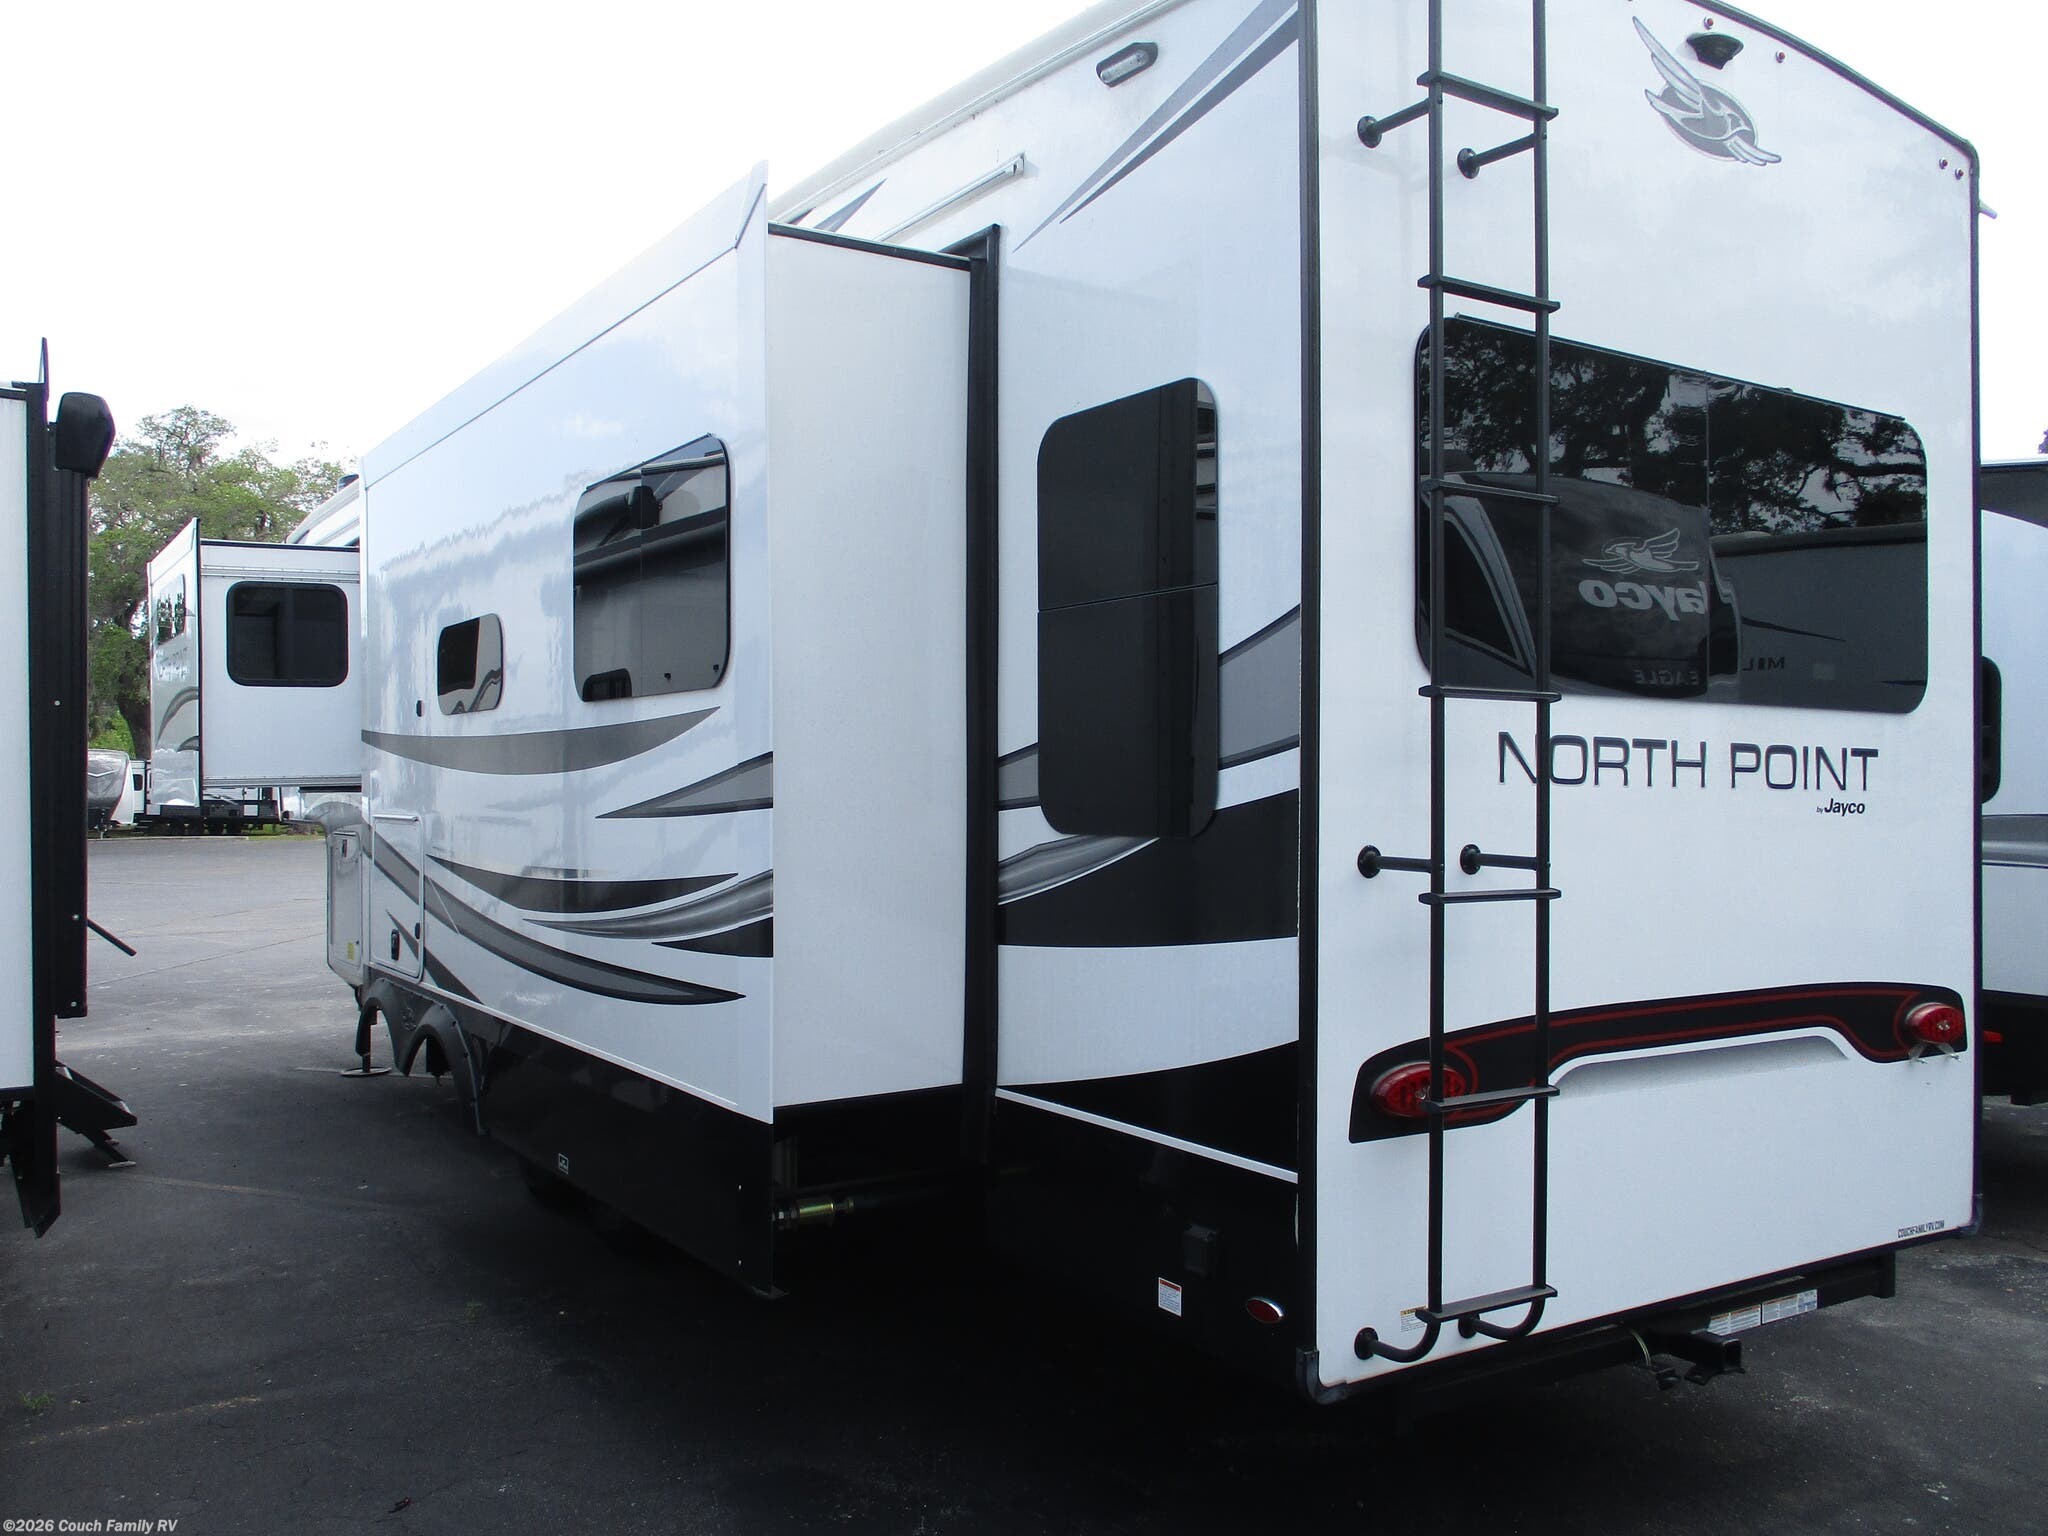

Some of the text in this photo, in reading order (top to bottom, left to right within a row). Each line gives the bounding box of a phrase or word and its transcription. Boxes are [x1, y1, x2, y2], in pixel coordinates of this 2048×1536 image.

[1498, 731, 1879, 791] NORTH POINT
[1816, 797, 1866, 817] by Jayco
